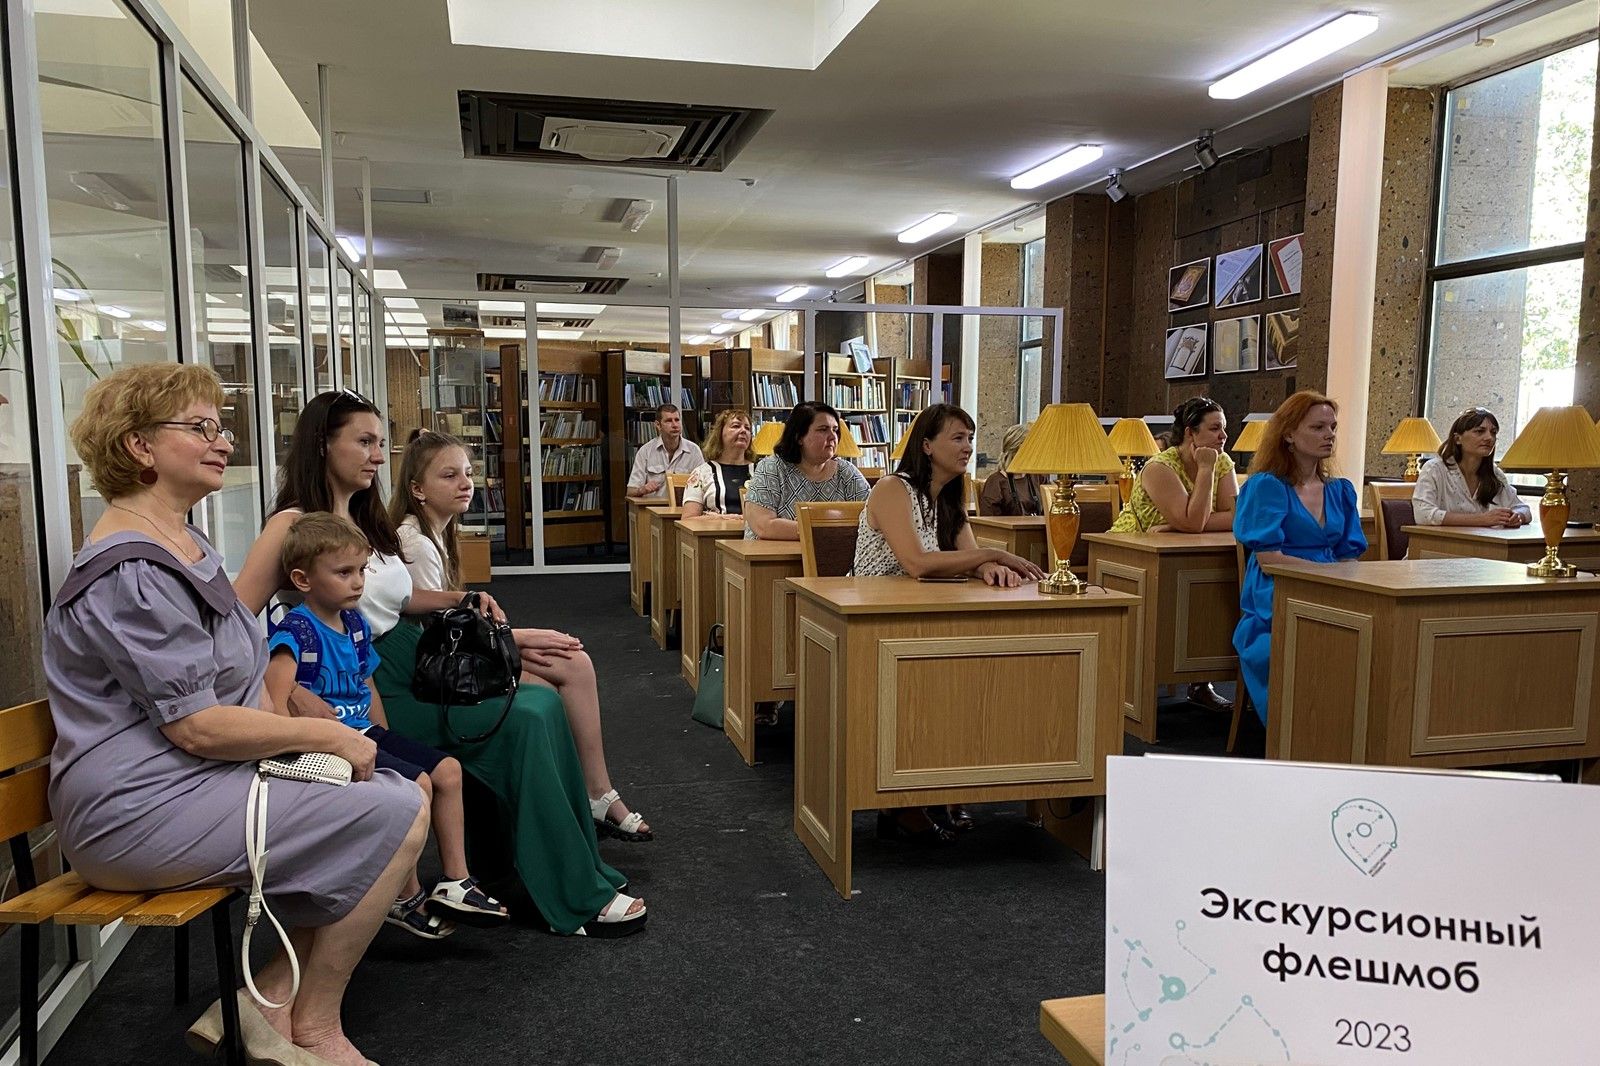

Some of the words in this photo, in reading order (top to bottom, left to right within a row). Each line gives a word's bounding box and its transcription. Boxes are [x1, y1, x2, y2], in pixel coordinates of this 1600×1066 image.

[1200, 887, 1542, 950] Экскурсионный
[1262, 942, 1480, 994] флешмоб
[1335, 1018, 1412, 1053] 2023
